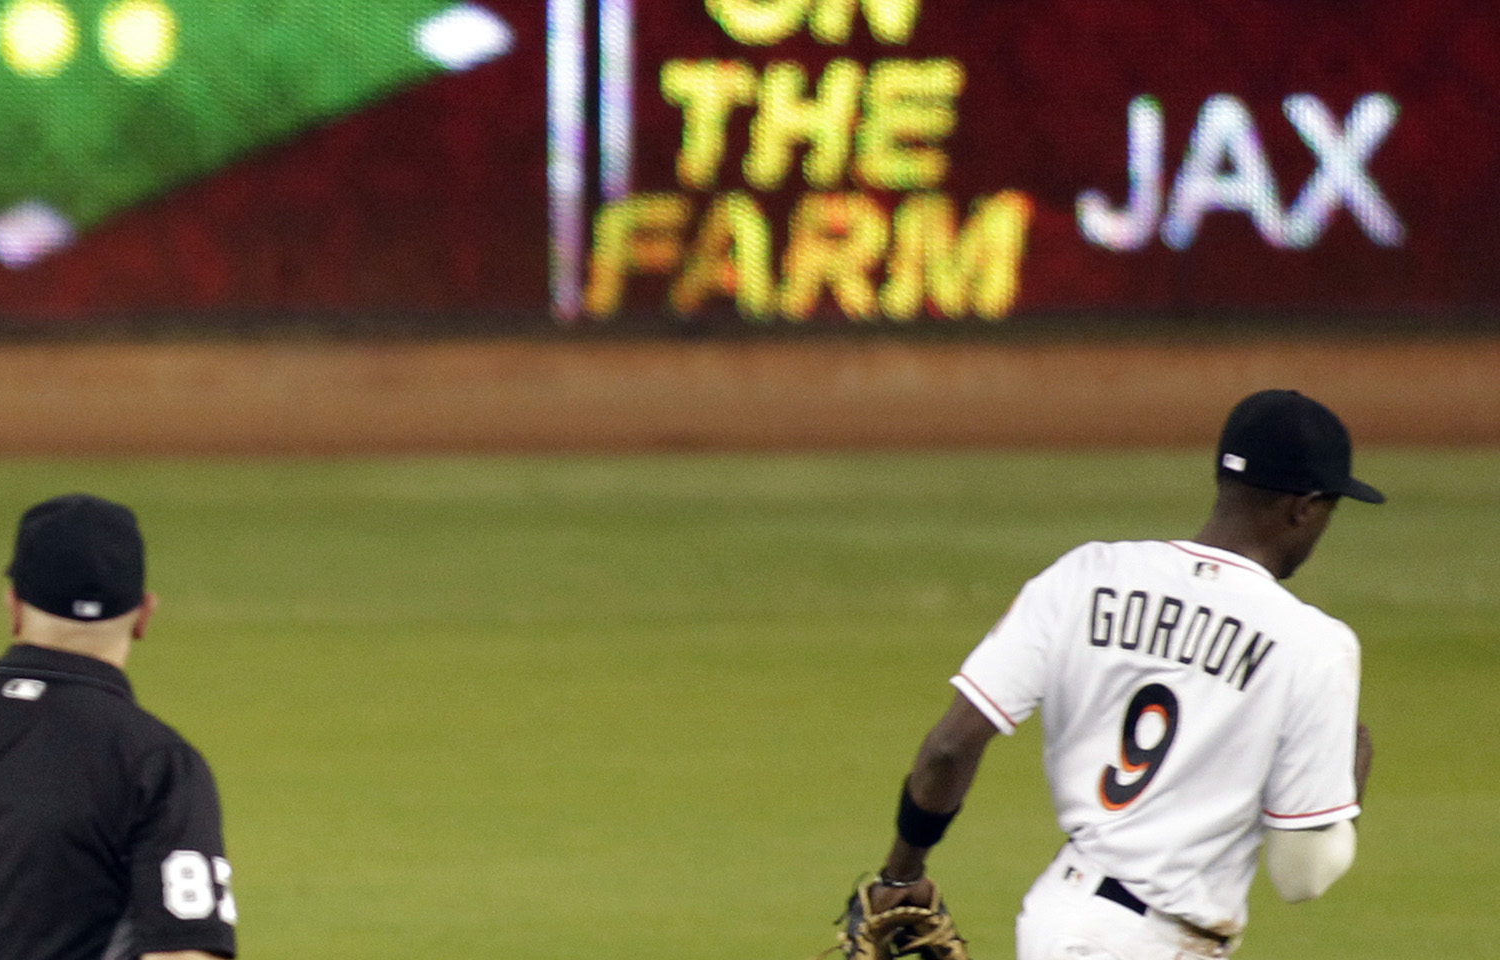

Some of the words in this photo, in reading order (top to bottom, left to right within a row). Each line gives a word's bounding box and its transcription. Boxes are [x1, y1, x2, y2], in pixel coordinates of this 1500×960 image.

[660, 58, 965, 192] THE
[1076, 94, 1406, 252] JAX
[583, 188, 1034, 322] FARM
[1090, 586, 1277, 692] GORDON
[1099, 682, 1180, 812] 9
